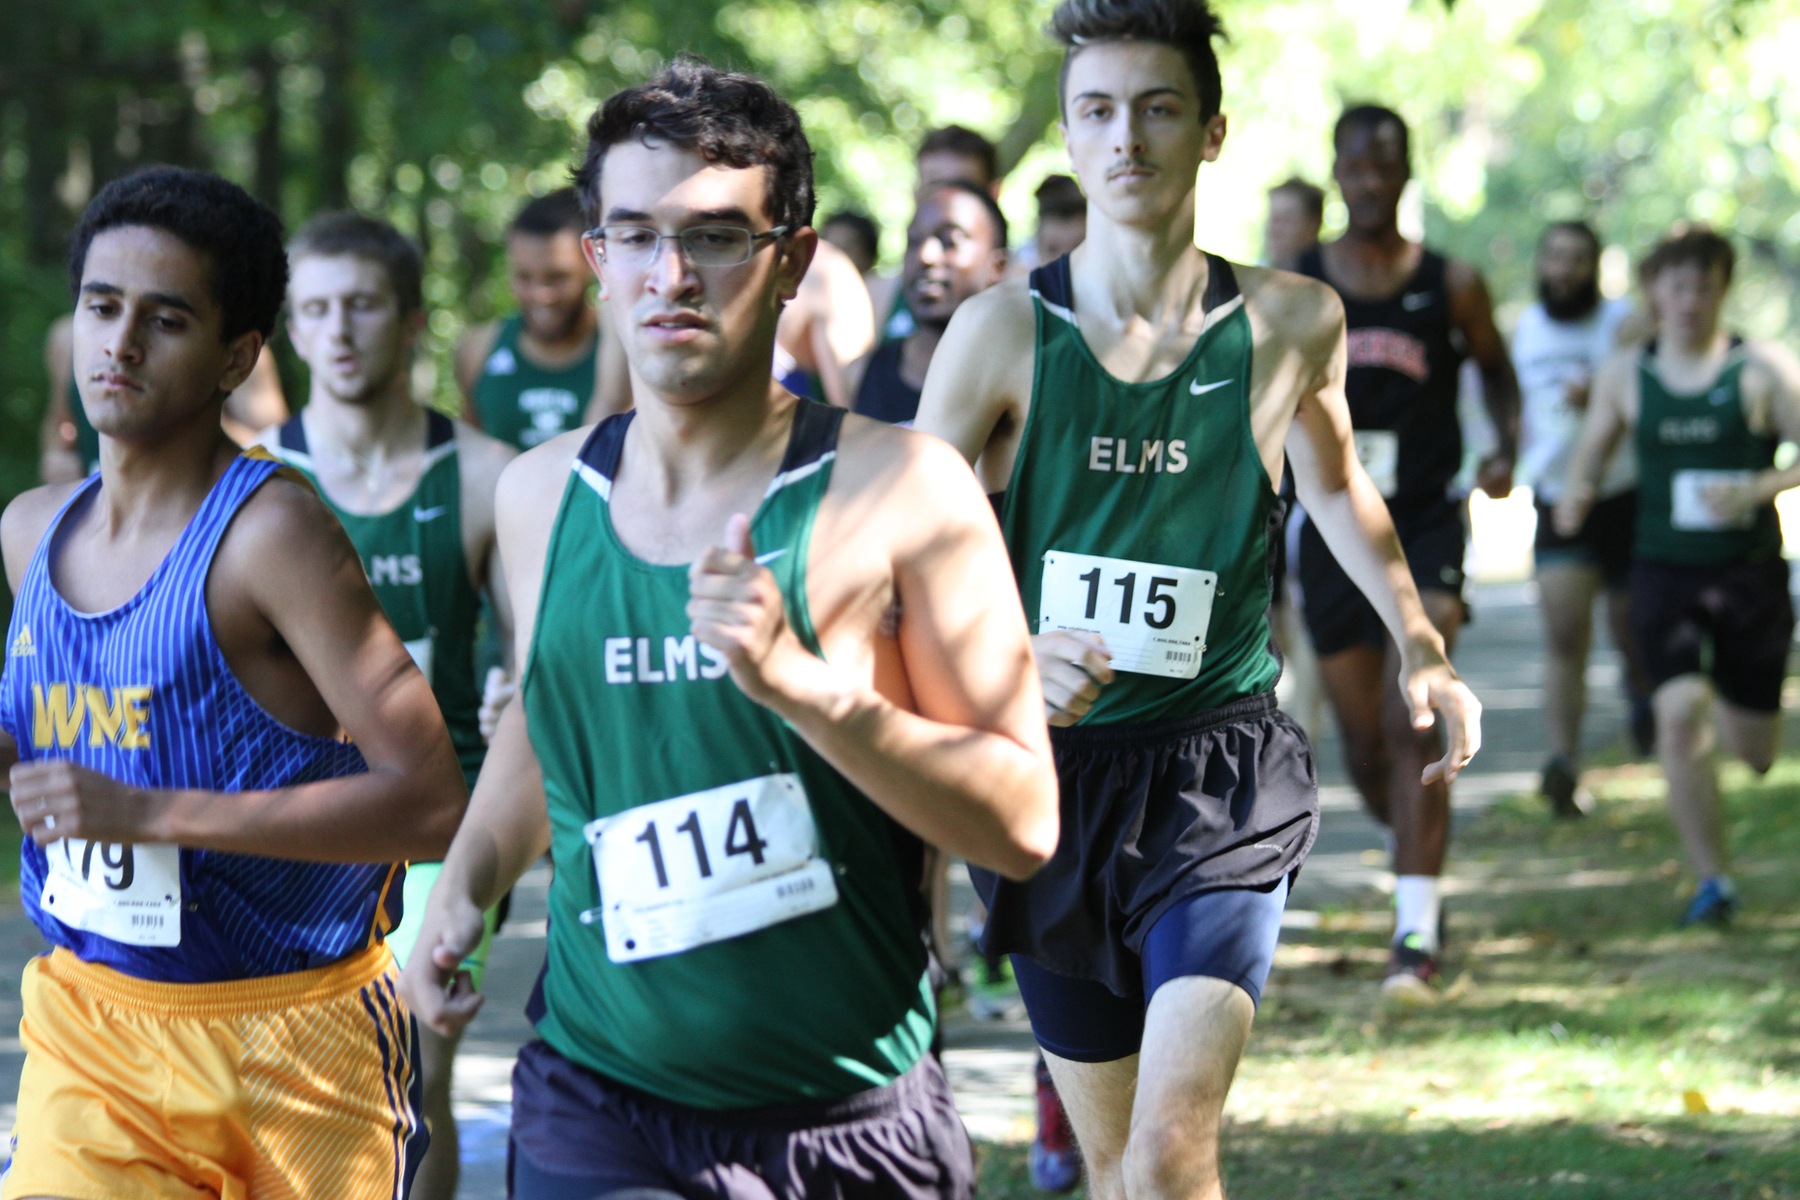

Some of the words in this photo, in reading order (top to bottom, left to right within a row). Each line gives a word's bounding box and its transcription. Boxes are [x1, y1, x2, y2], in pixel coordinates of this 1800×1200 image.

[1089, 436, 1188, 474] ELMS
[367, 555, 423, 586] MS
[1079, 568, 1178, 629] 115
[604, 635, 729, 684] ELMS
[31, 682, 153, 750] WNE
[636, 798, 768, 889] 114
